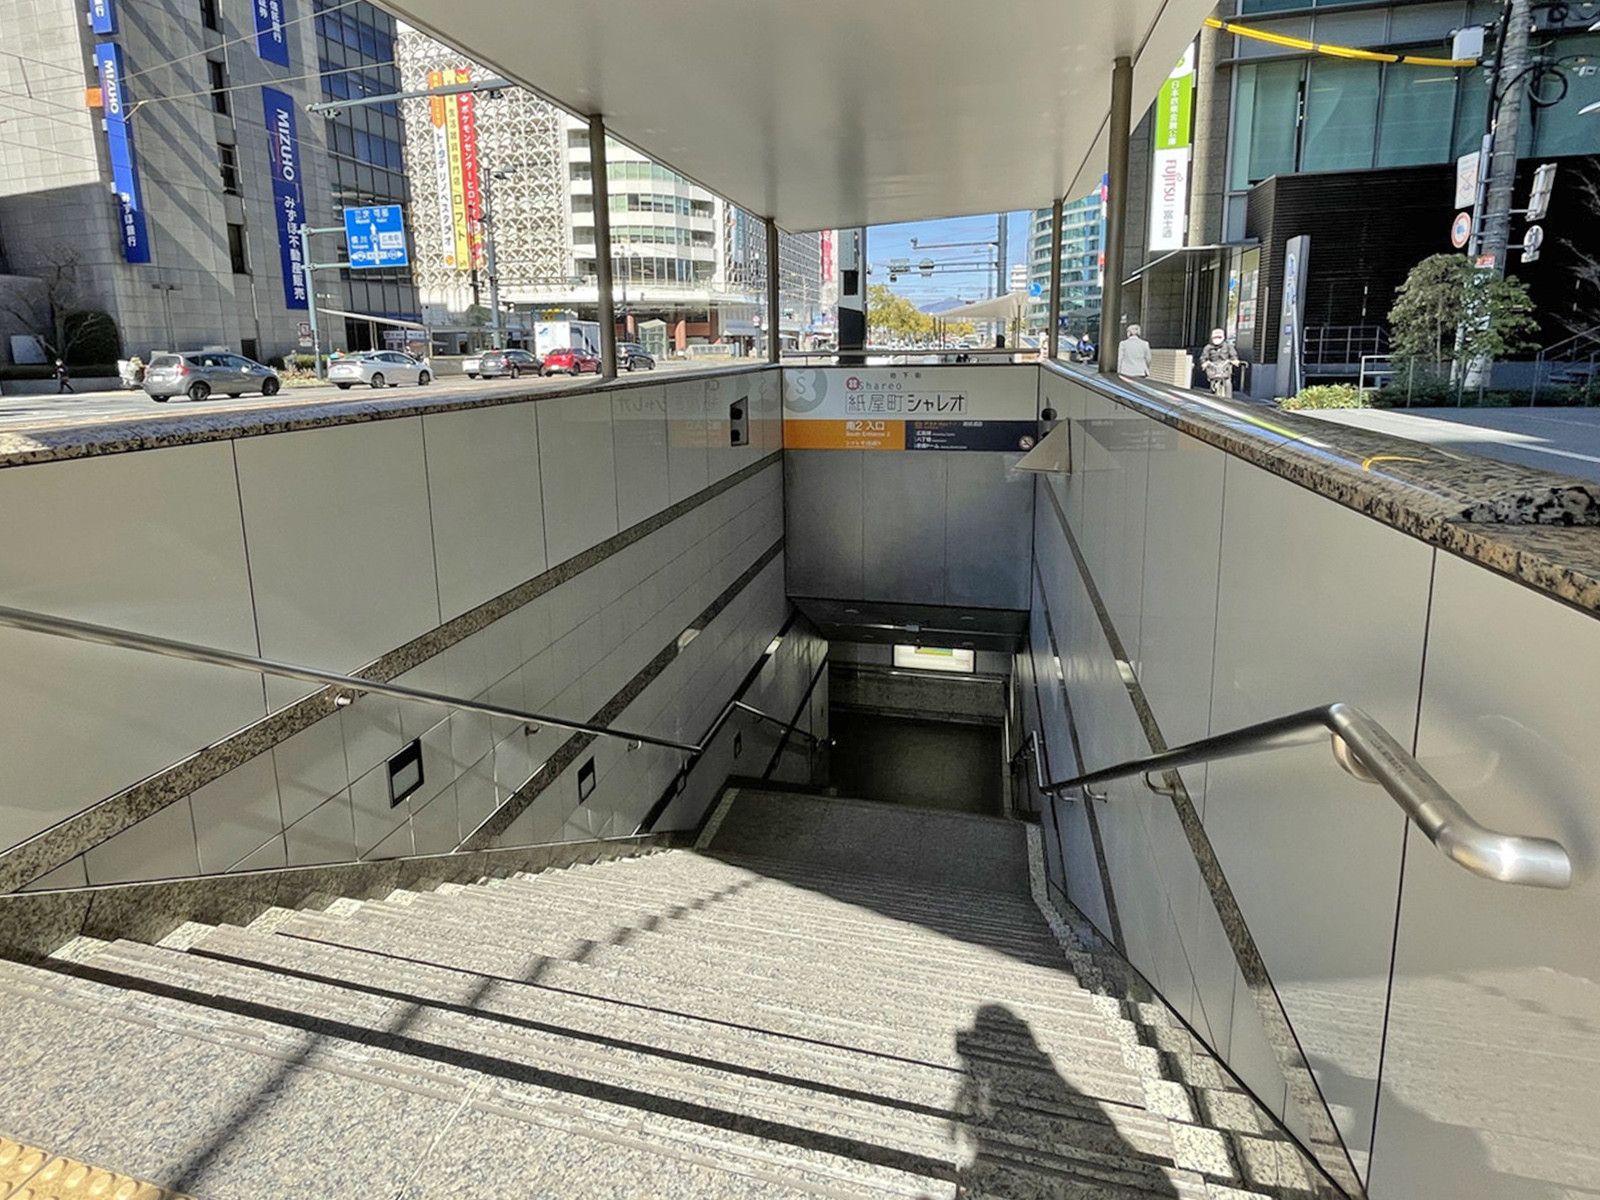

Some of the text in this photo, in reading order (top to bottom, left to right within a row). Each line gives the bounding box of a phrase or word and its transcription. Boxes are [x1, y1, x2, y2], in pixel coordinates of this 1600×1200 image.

[104, 60, 119, 114] MIZUHO
[276, 108, 295, 181] MIZUHO
[1162, 160, 1178, 202] FUJITSU
[121, 192, 136, 247] みずほ銀行
[454, 194, 466, 241] ロフト
[284, 195, 306, 300] みずほ不動産販売
[848, 393, 965, 412] 紙屋町シャレオ
[858, 381, 902, 391] Shareo
